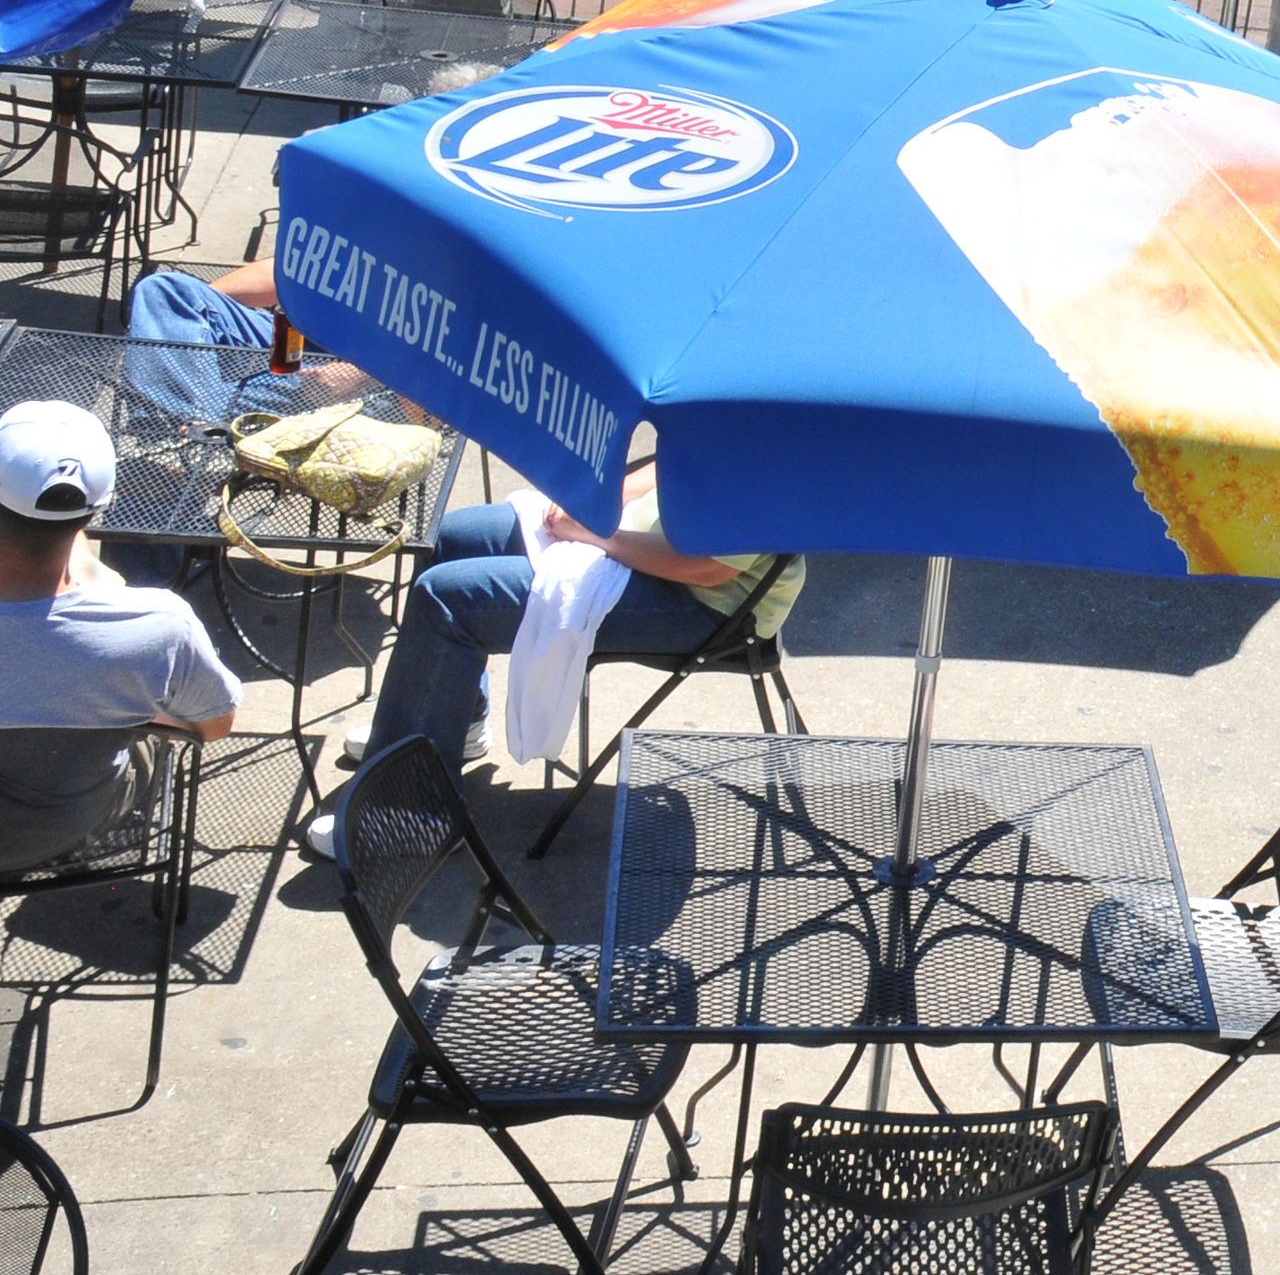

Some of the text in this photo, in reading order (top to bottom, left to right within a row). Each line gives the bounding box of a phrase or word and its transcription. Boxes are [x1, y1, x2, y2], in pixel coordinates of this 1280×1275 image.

[455, 115, 741, 192] Lite
[602, 91, 742, 139] Miller
[282, 216, 377, 314] GREAT
[377, 263, 464, 377] TASTE...
[469, 322, 534, 415] LESS
